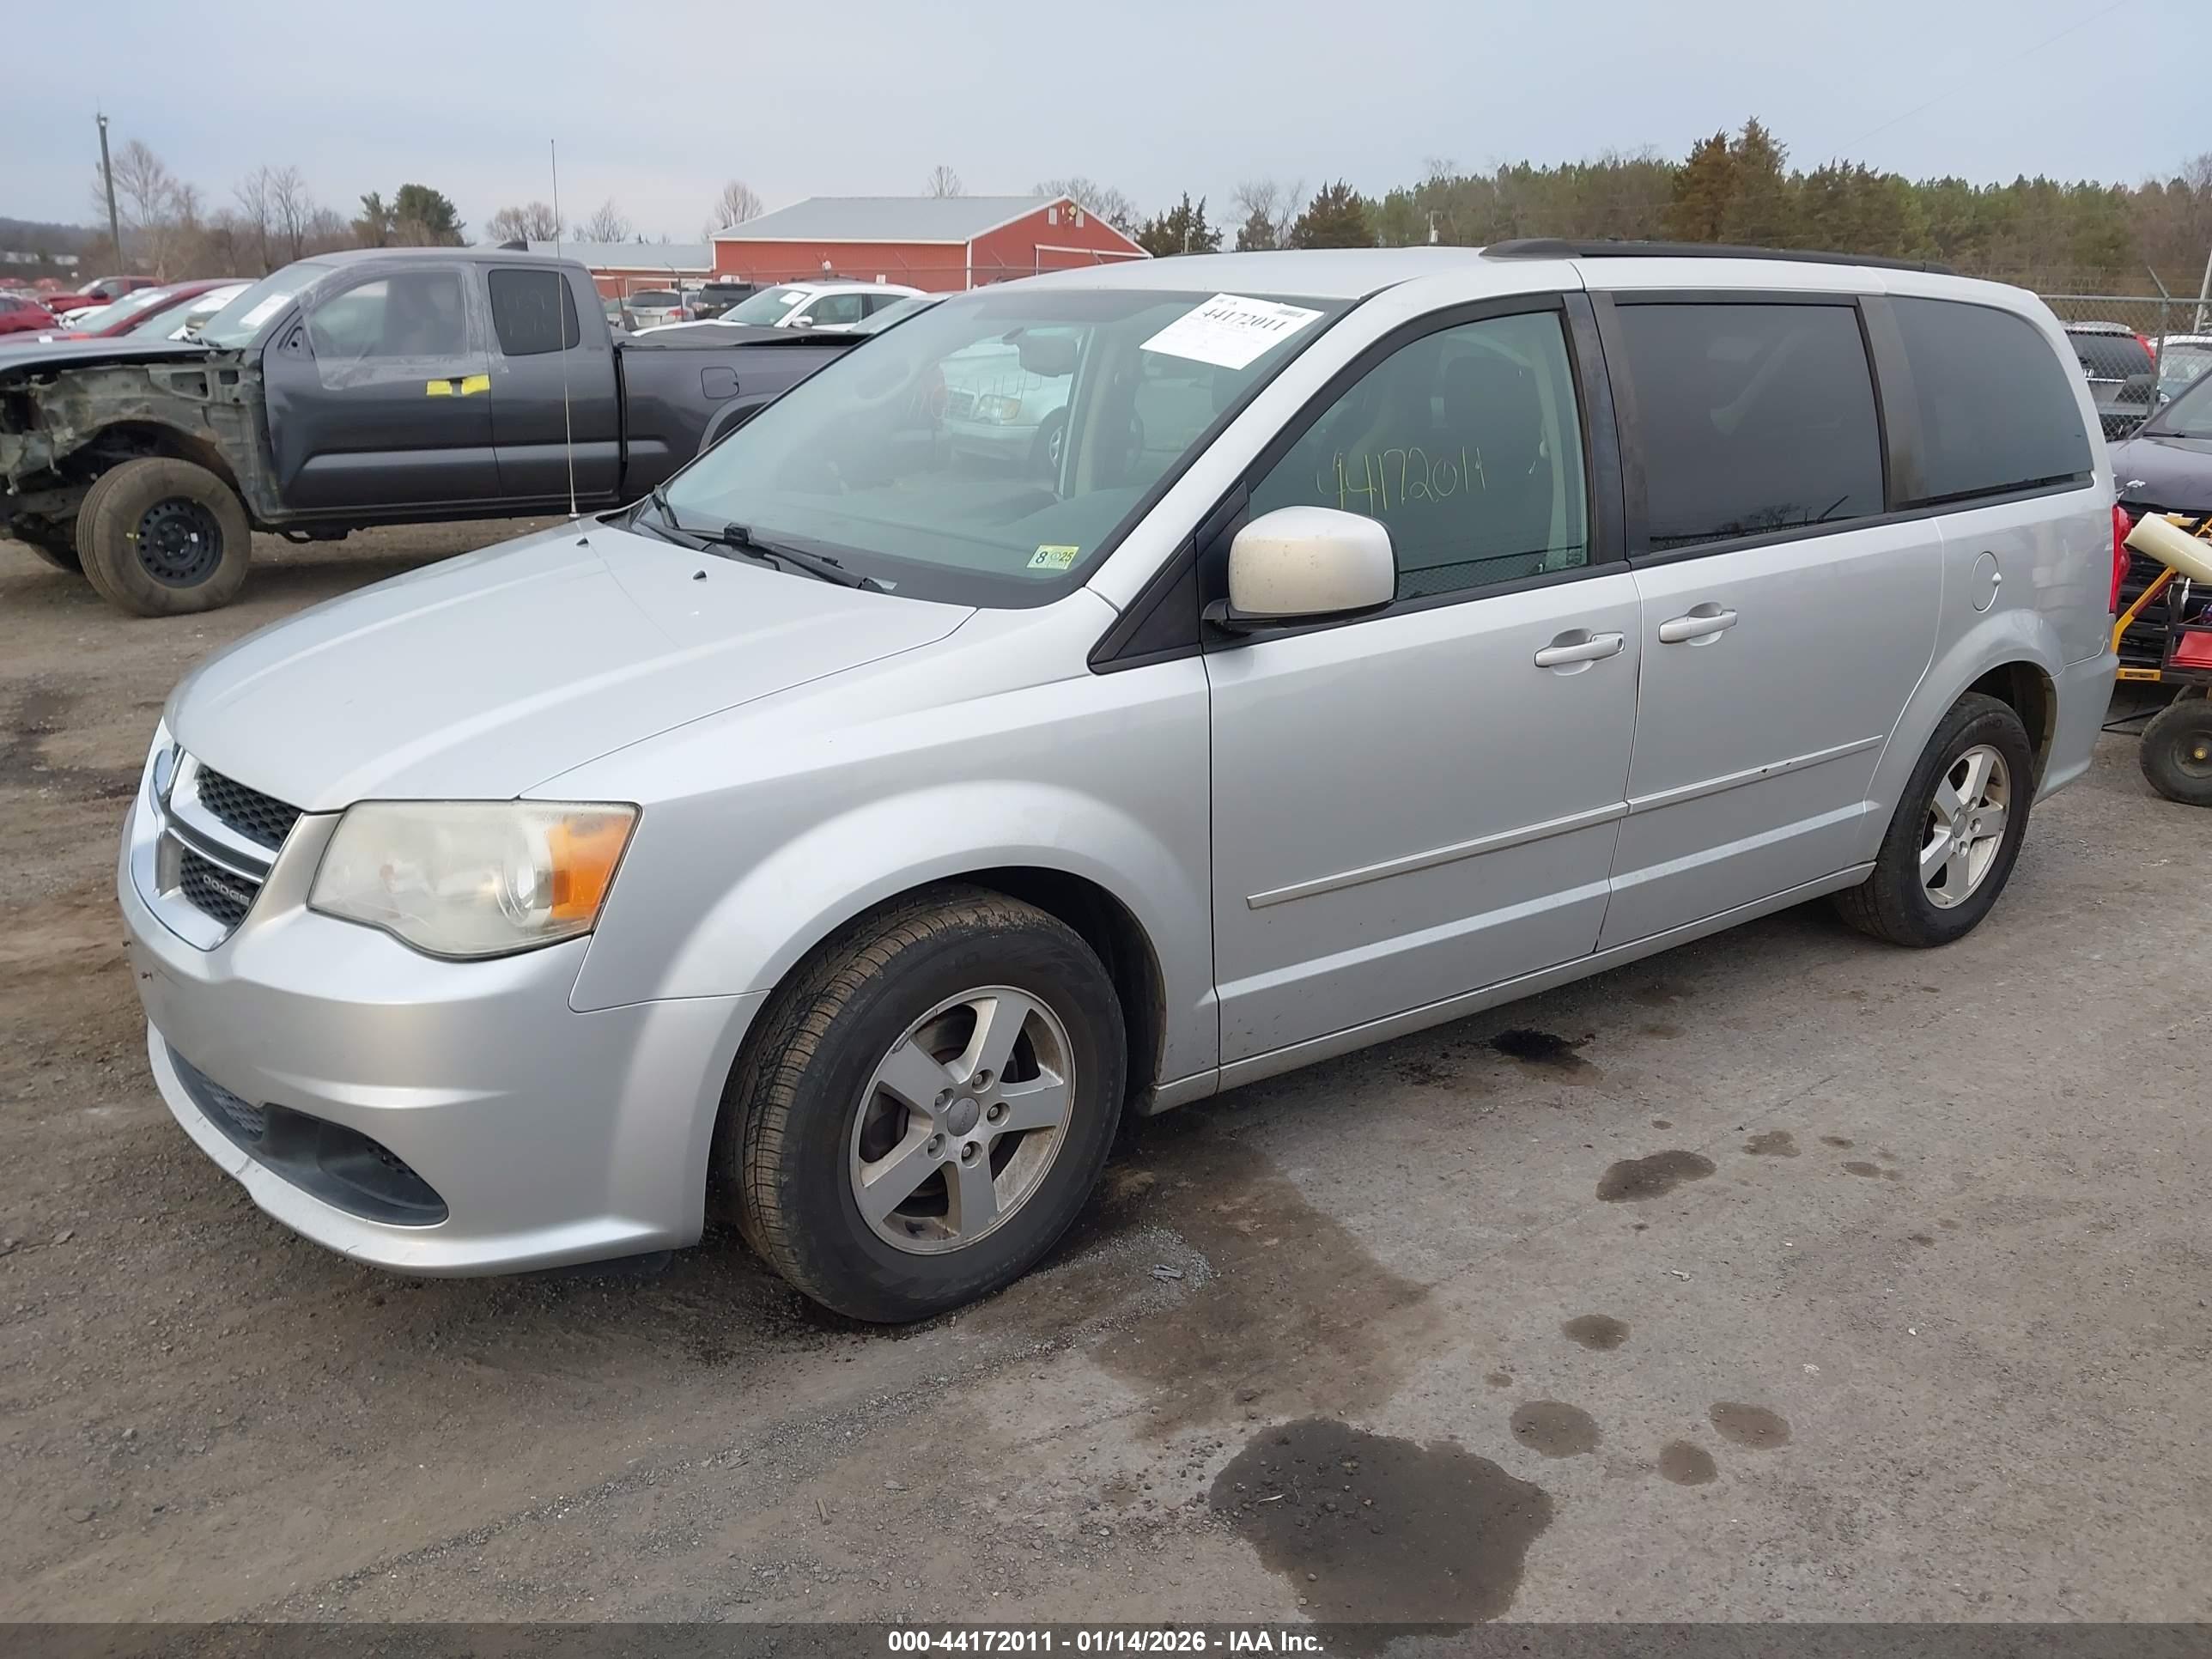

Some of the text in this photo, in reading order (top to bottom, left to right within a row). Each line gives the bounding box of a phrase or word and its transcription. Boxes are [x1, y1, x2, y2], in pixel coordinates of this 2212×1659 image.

[1201, 307, 1288, 331] 44172011
[1035, 550, 1074, 564] 8 25
[202, 873, 251, 905] DODGE
